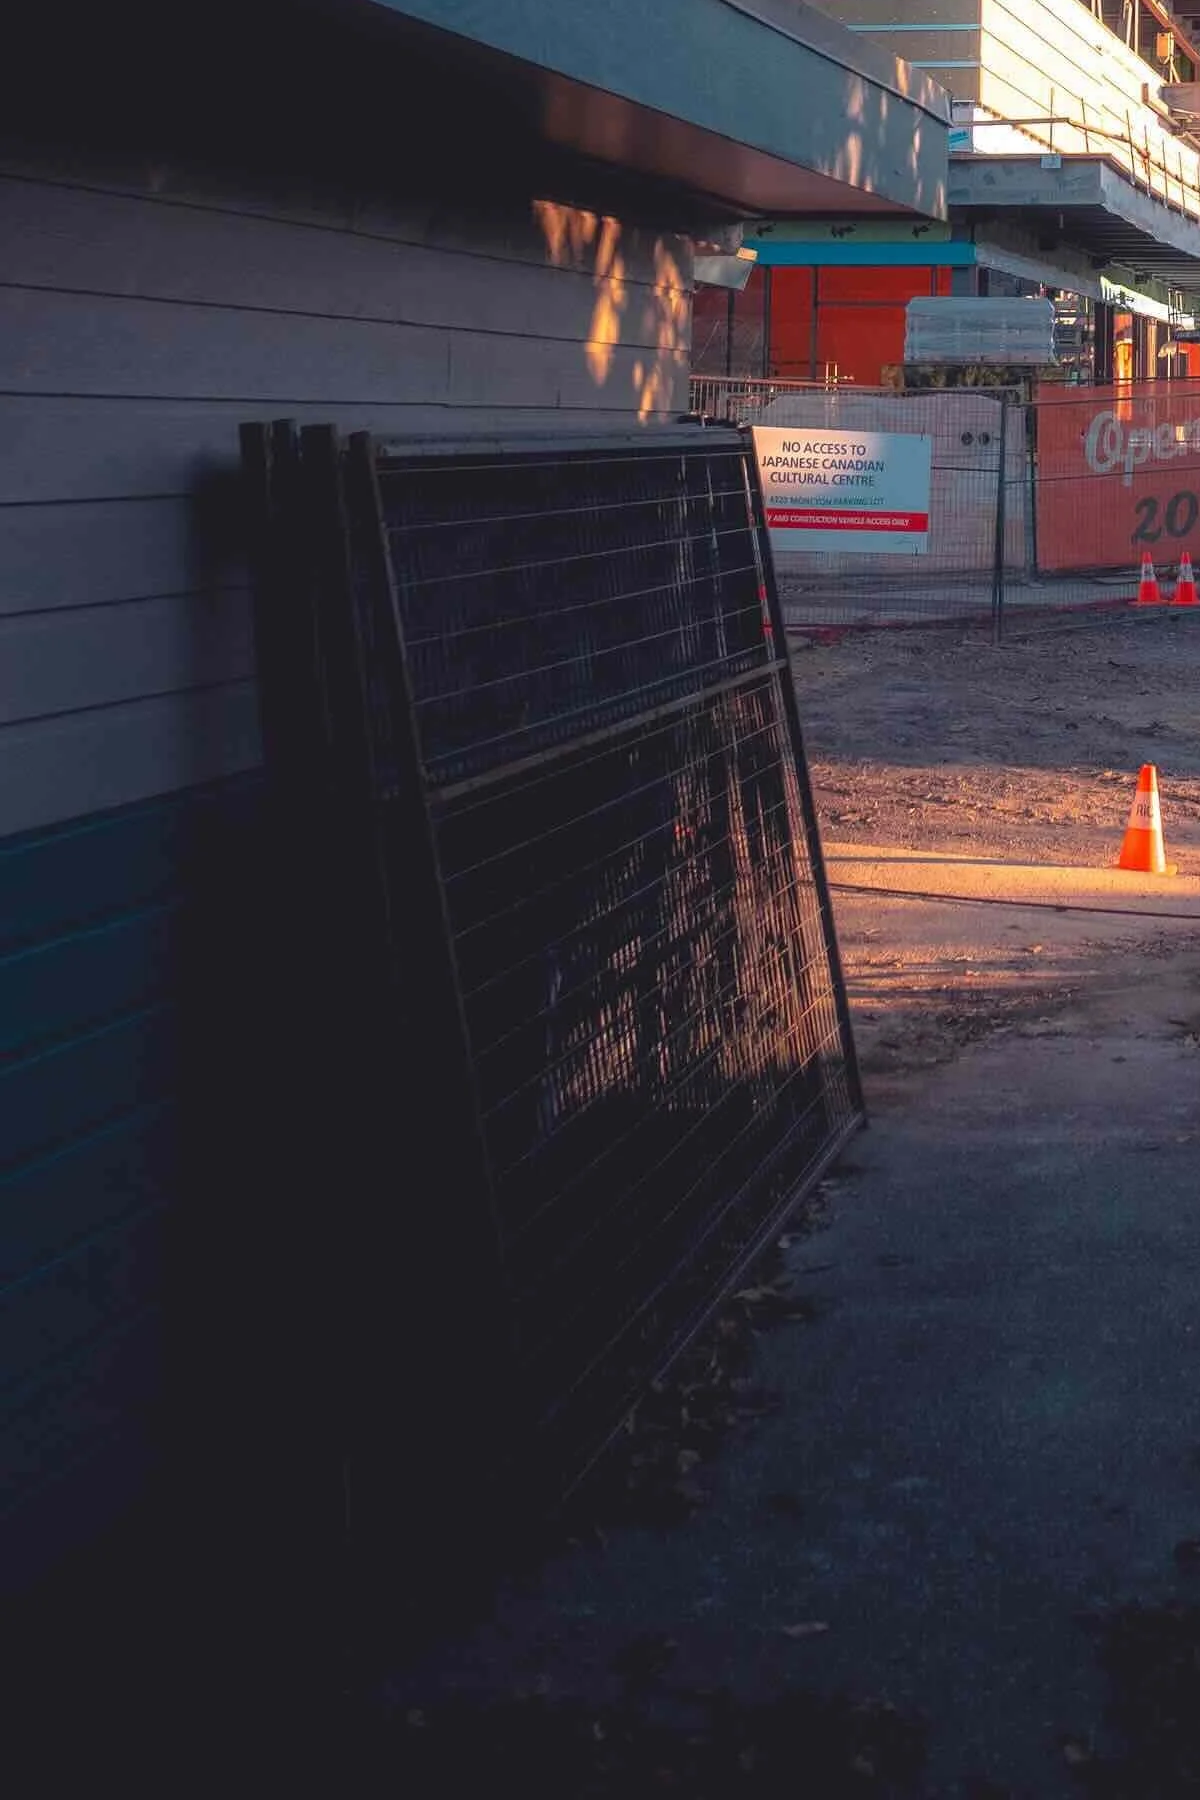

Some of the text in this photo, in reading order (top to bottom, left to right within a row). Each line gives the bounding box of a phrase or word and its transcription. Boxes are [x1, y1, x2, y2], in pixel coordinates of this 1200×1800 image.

[782, 441, 866, 456] NO ACCESS TO
[762, 455, 885, 472] JAPANESE CANADIAN
[770, 471, 875, 487] CULTURAL CENTRE
[772, 514, 788, 523] AND
[838, 516, 865, 525] VEHICLE
[864, 517, 891, 526] ACCESS
[891, 518, 910, 527] ONLY
